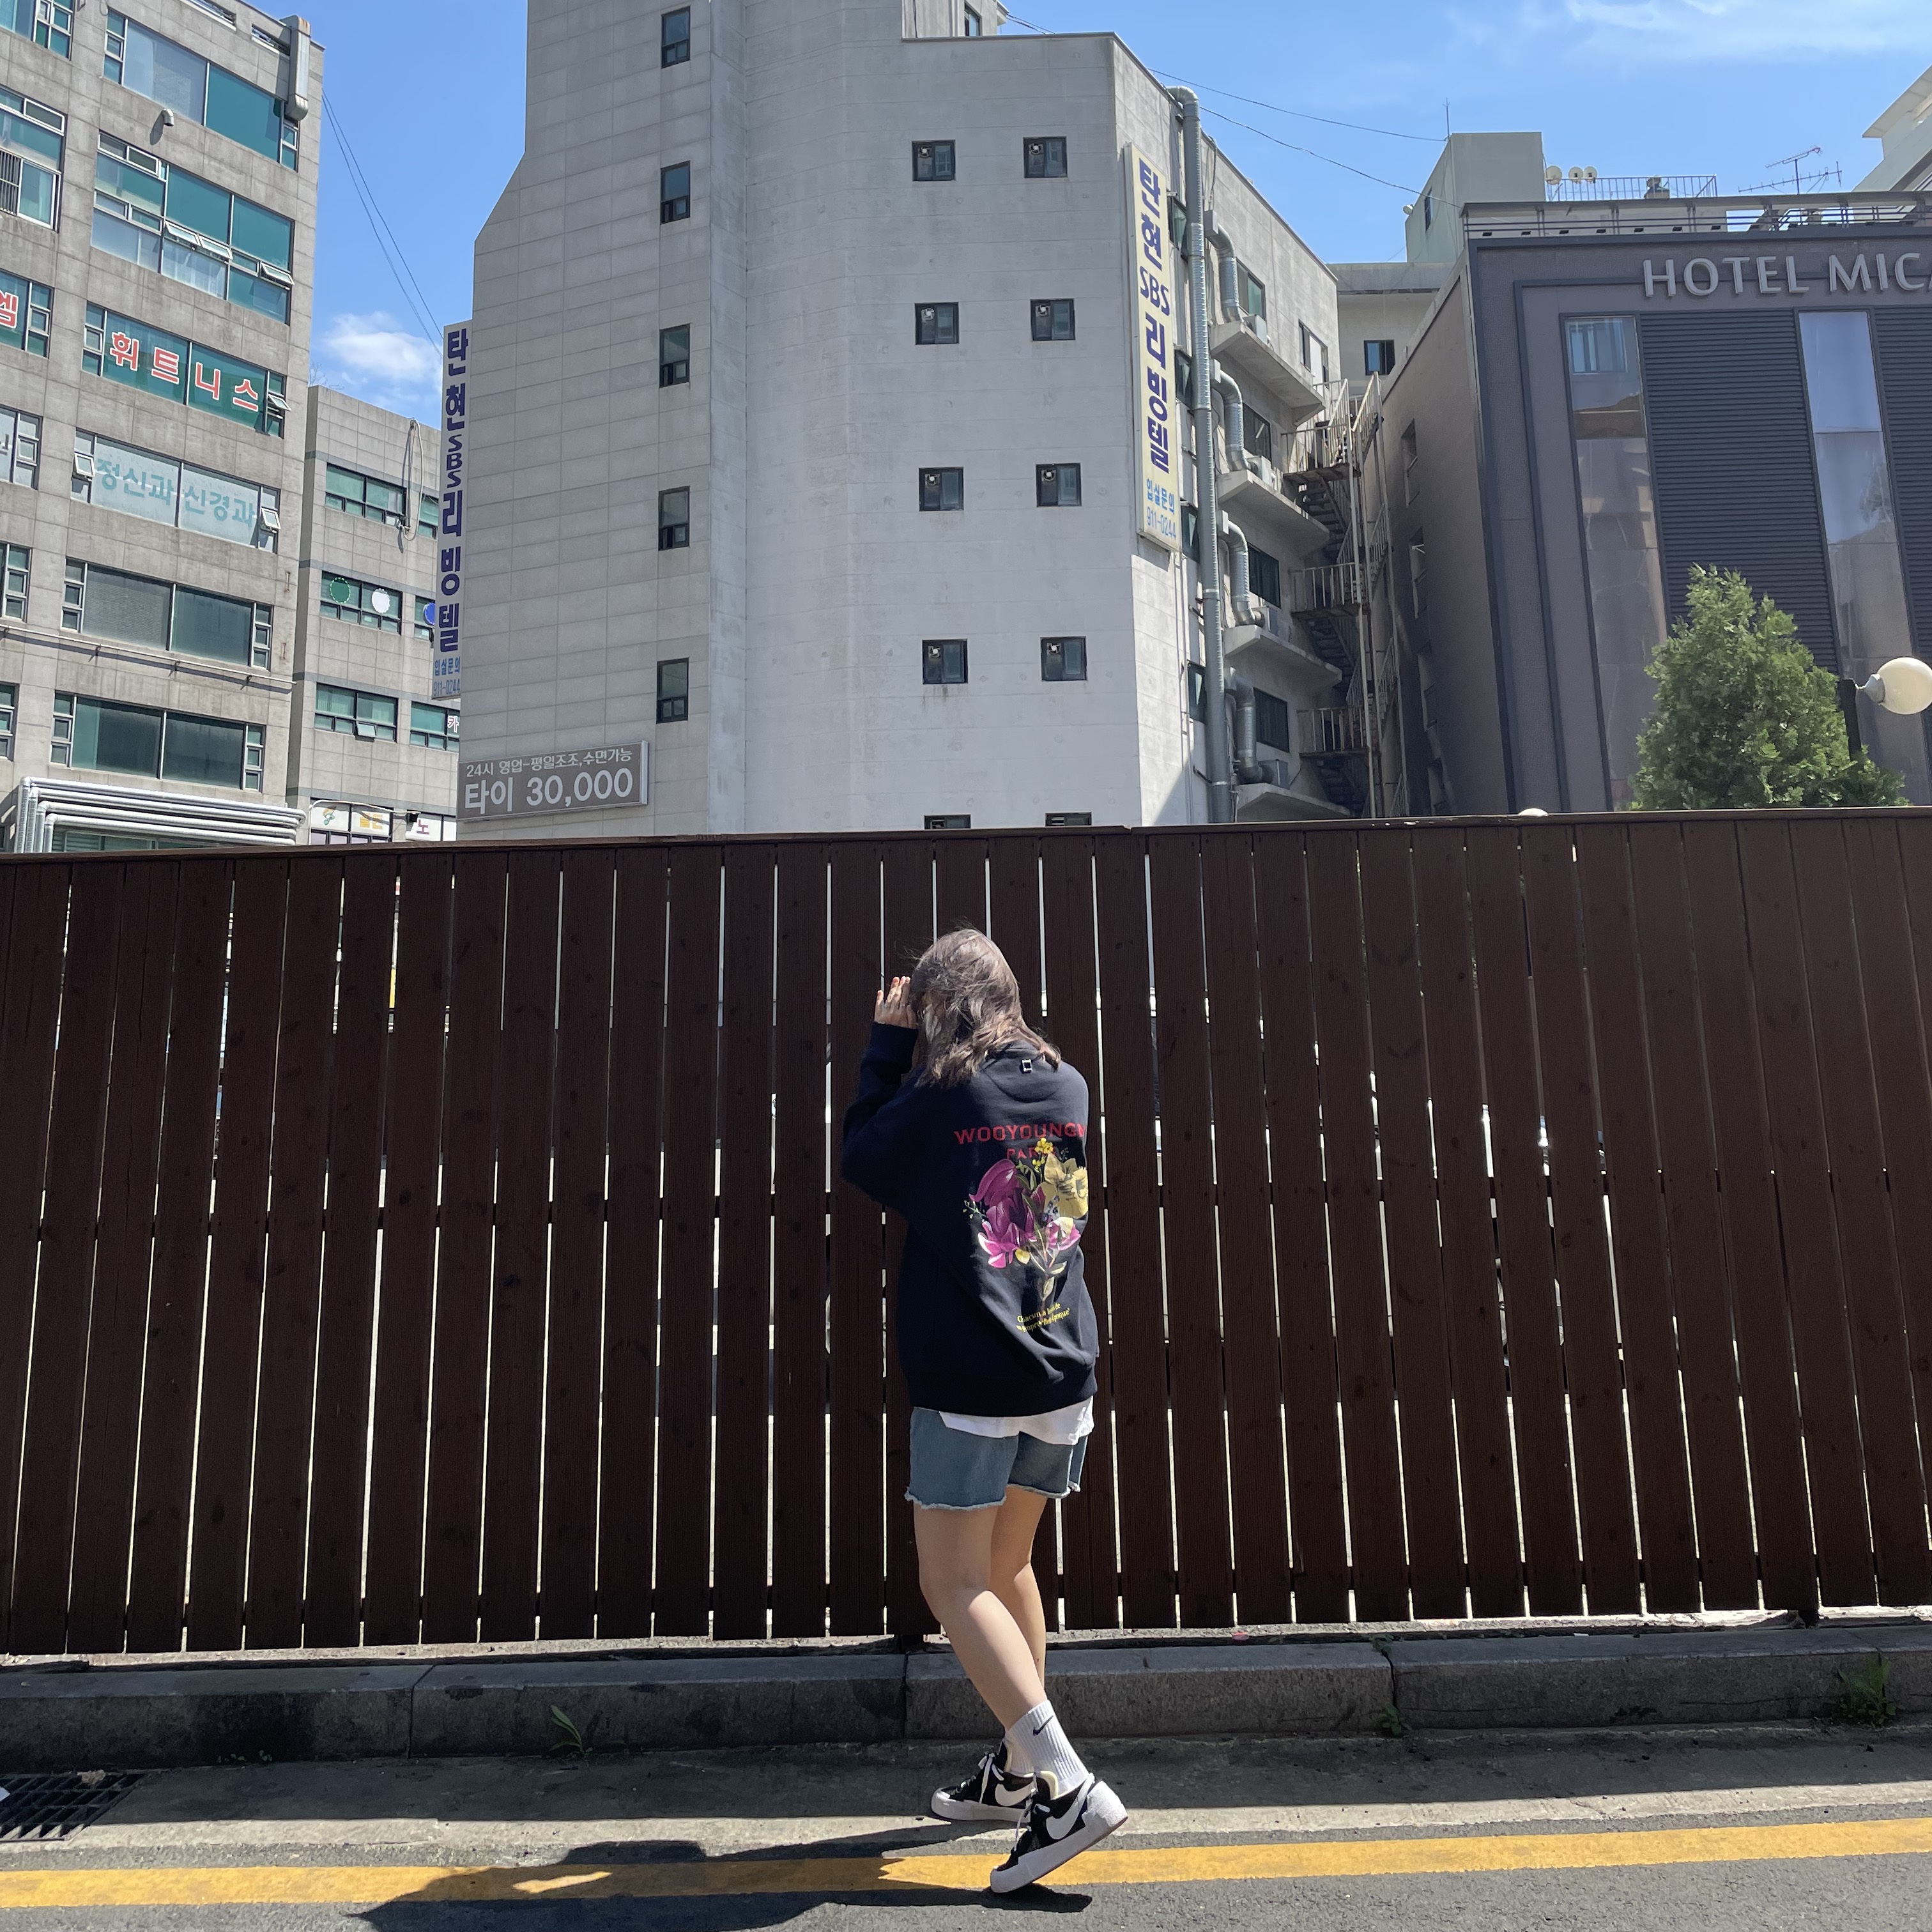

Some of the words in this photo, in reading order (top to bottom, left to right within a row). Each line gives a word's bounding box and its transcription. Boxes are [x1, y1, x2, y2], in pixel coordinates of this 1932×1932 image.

[1643, 256, 1809, 297] HOTEL
[1828, 252, 1932, 292] MIC
[110, 332, 258, 412] 휘트니스
[97, 458, 174, 505] 정신과
[184, 486, 255, 528] 신경과
[1146, 479, 1175, 515] 입실문의
[1147, 507, 1176, 540] 911-0244
[434, 656, 460, 675] 입실문의
[434, 678, 460, 696] 911-0244
[466, 763, 493, 778] 24시
[464, 777, 514, 815] 타이
[526, 767, 633, 808] 30,000
